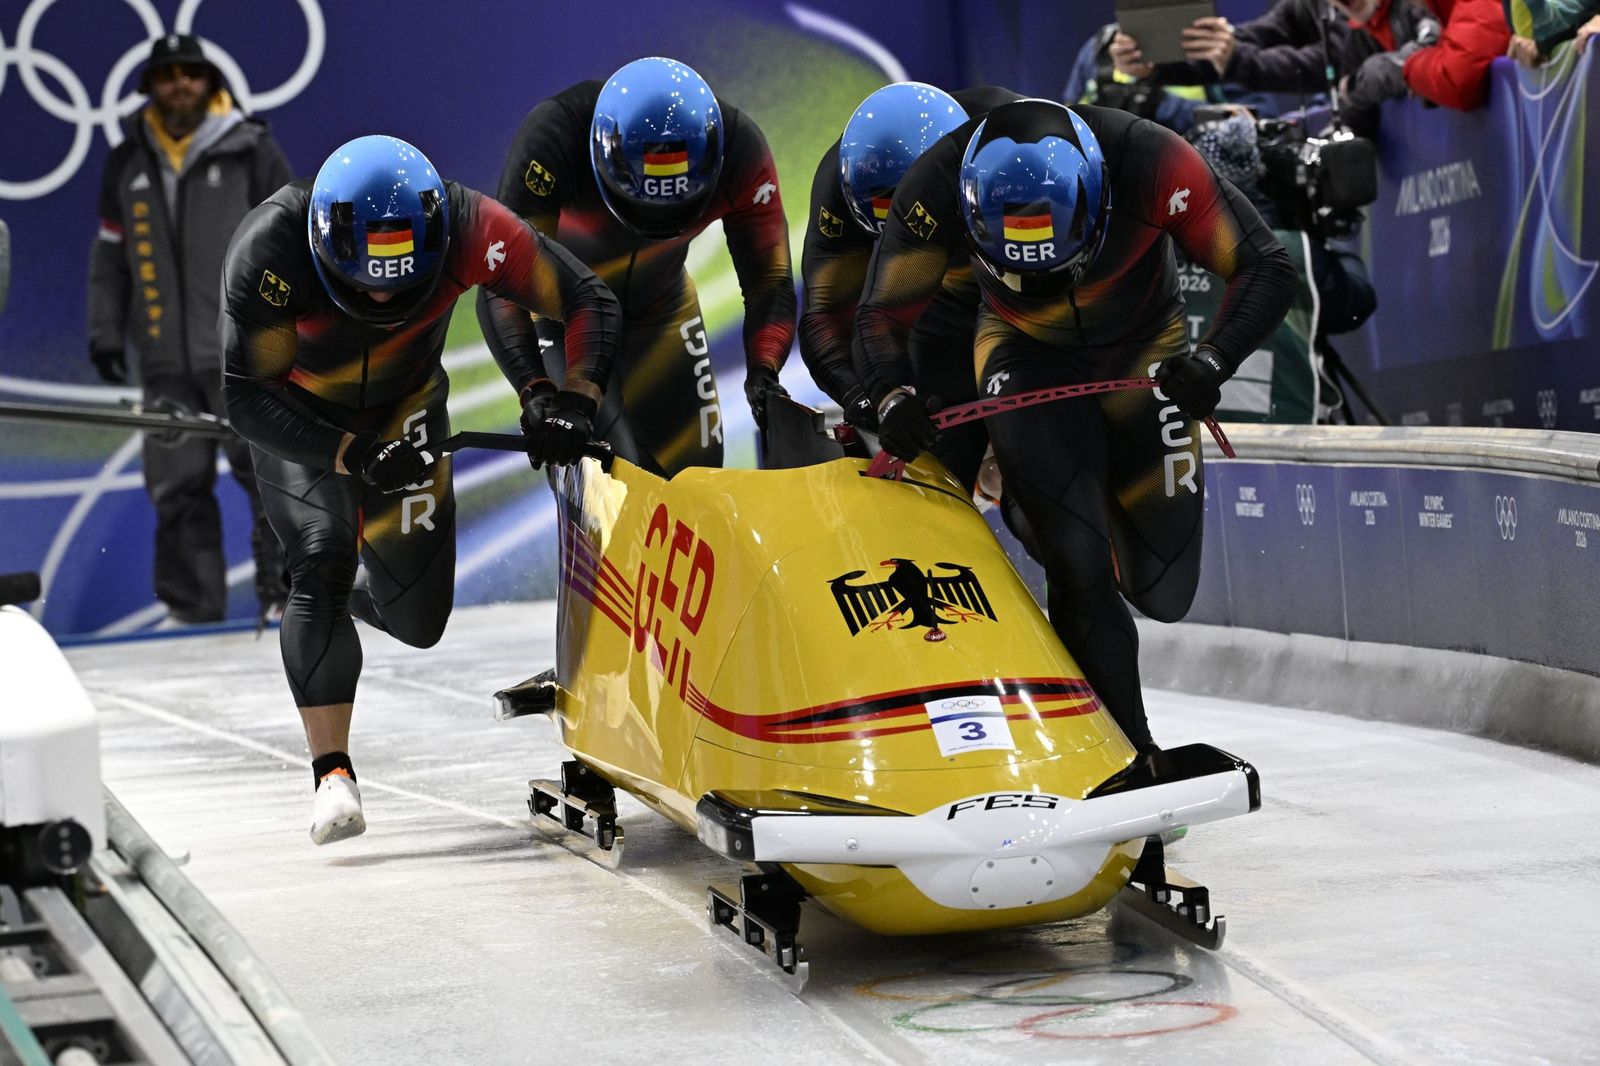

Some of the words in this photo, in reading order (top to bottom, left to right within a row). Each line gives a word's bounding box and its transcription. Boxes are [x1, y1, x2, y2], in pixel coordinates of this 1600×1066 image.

[644, 176, 689, 196] GER
[1004, 242, 1056, 262] GER
[367, 256, 415, 278] GER
[1178, 274, 1211, 292] 026
[545, 417, 574, 430] SEIZ
[401, 409, 436, 535] GR
[958, 721, 987, 741] 3
[946, 794, 1059, 820] FES
